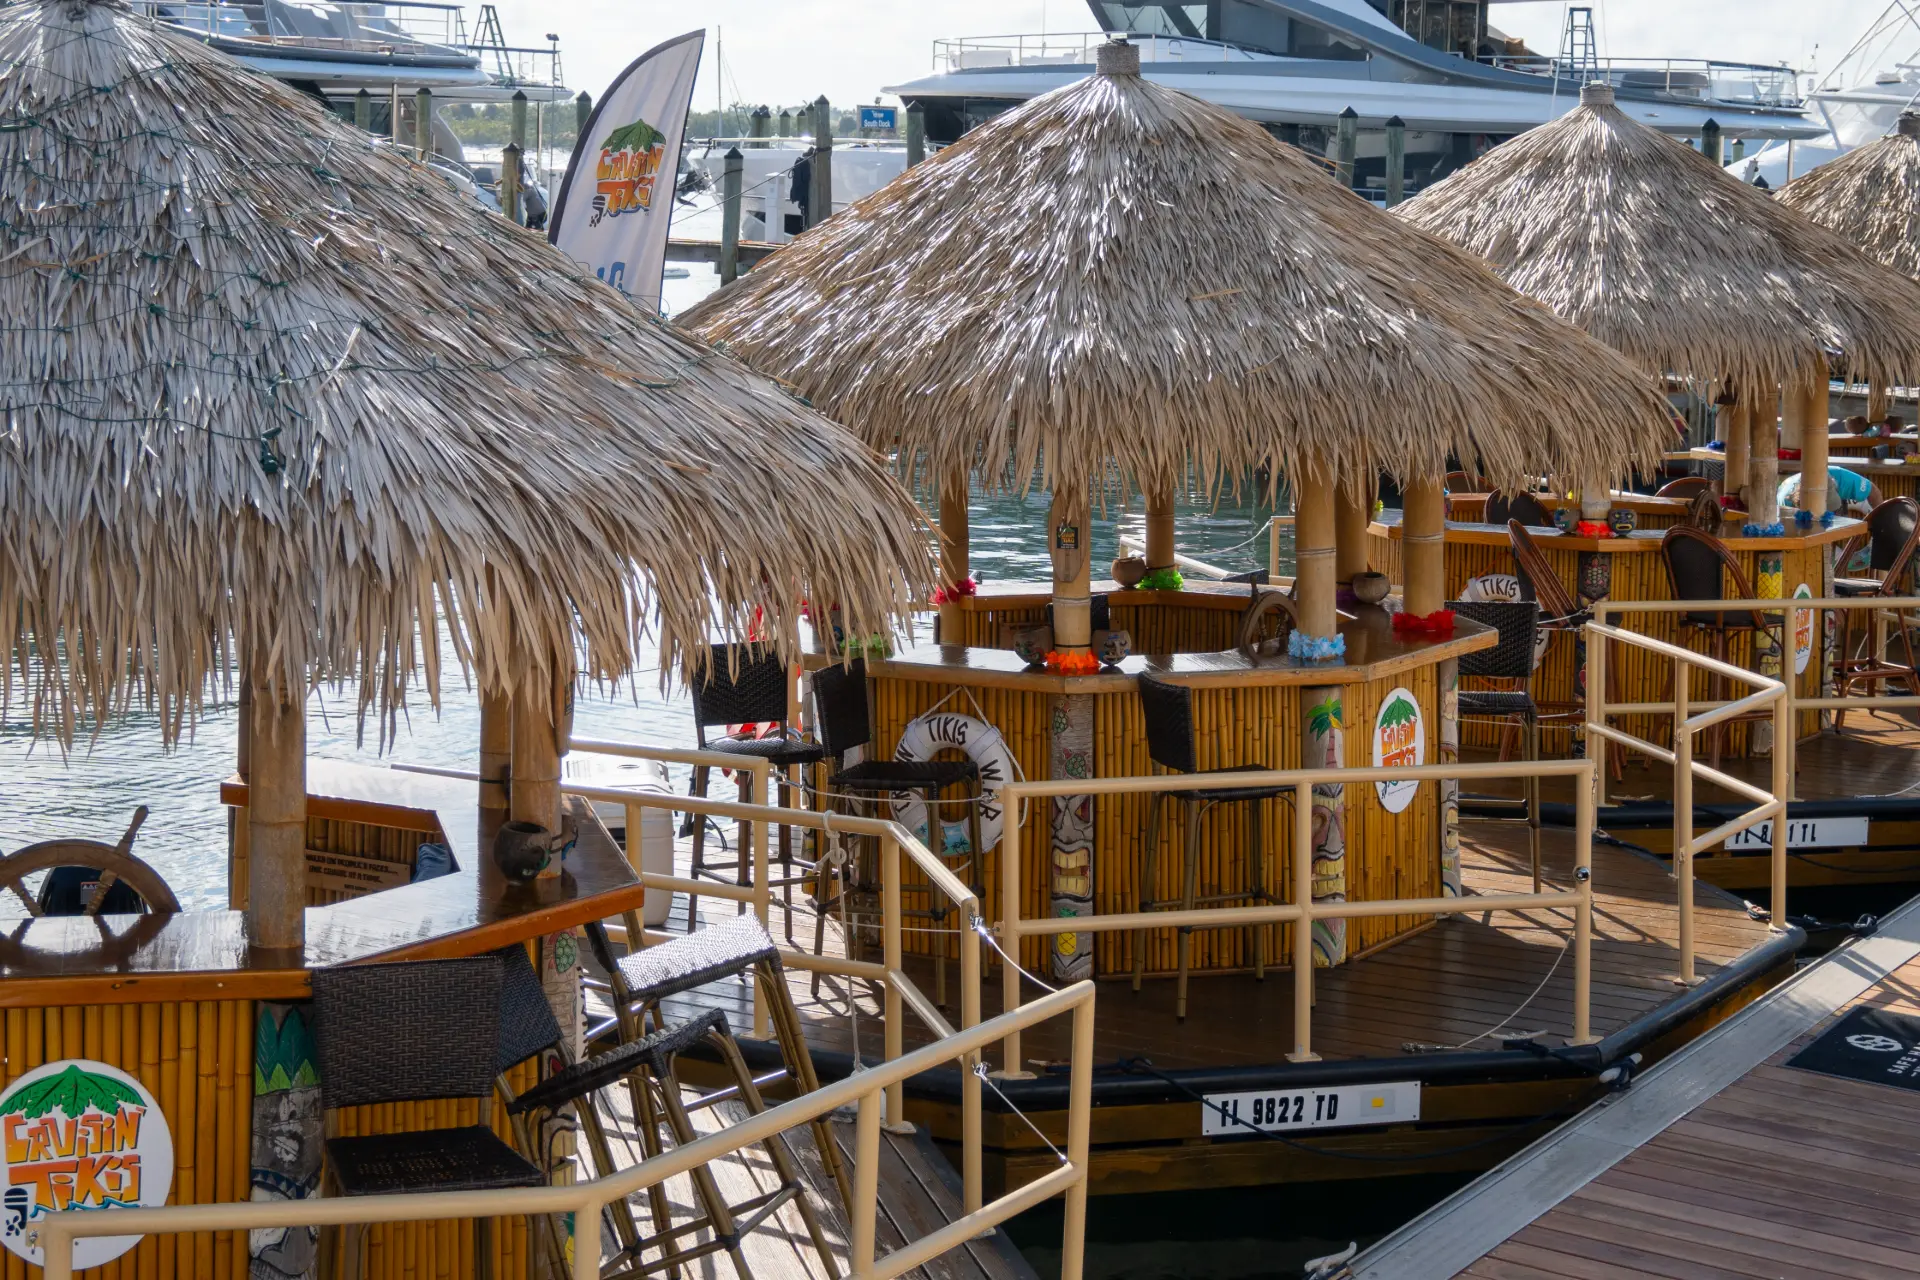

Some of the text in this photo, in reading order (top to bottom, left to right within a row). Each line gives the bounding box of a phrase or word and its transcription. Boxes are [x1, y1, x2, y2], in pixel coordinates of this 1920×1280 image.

[863, 119, 891, 128] South Dock
[1480, 577, 1518, 598] TIKIS
[925, 716, 968, 745] TIKIS
[1887, 1056, 1918, 1074] SAFE
[1252, 1095, 1305, 1126] 9822
[1315, 1094, 1339, 1121] TD
